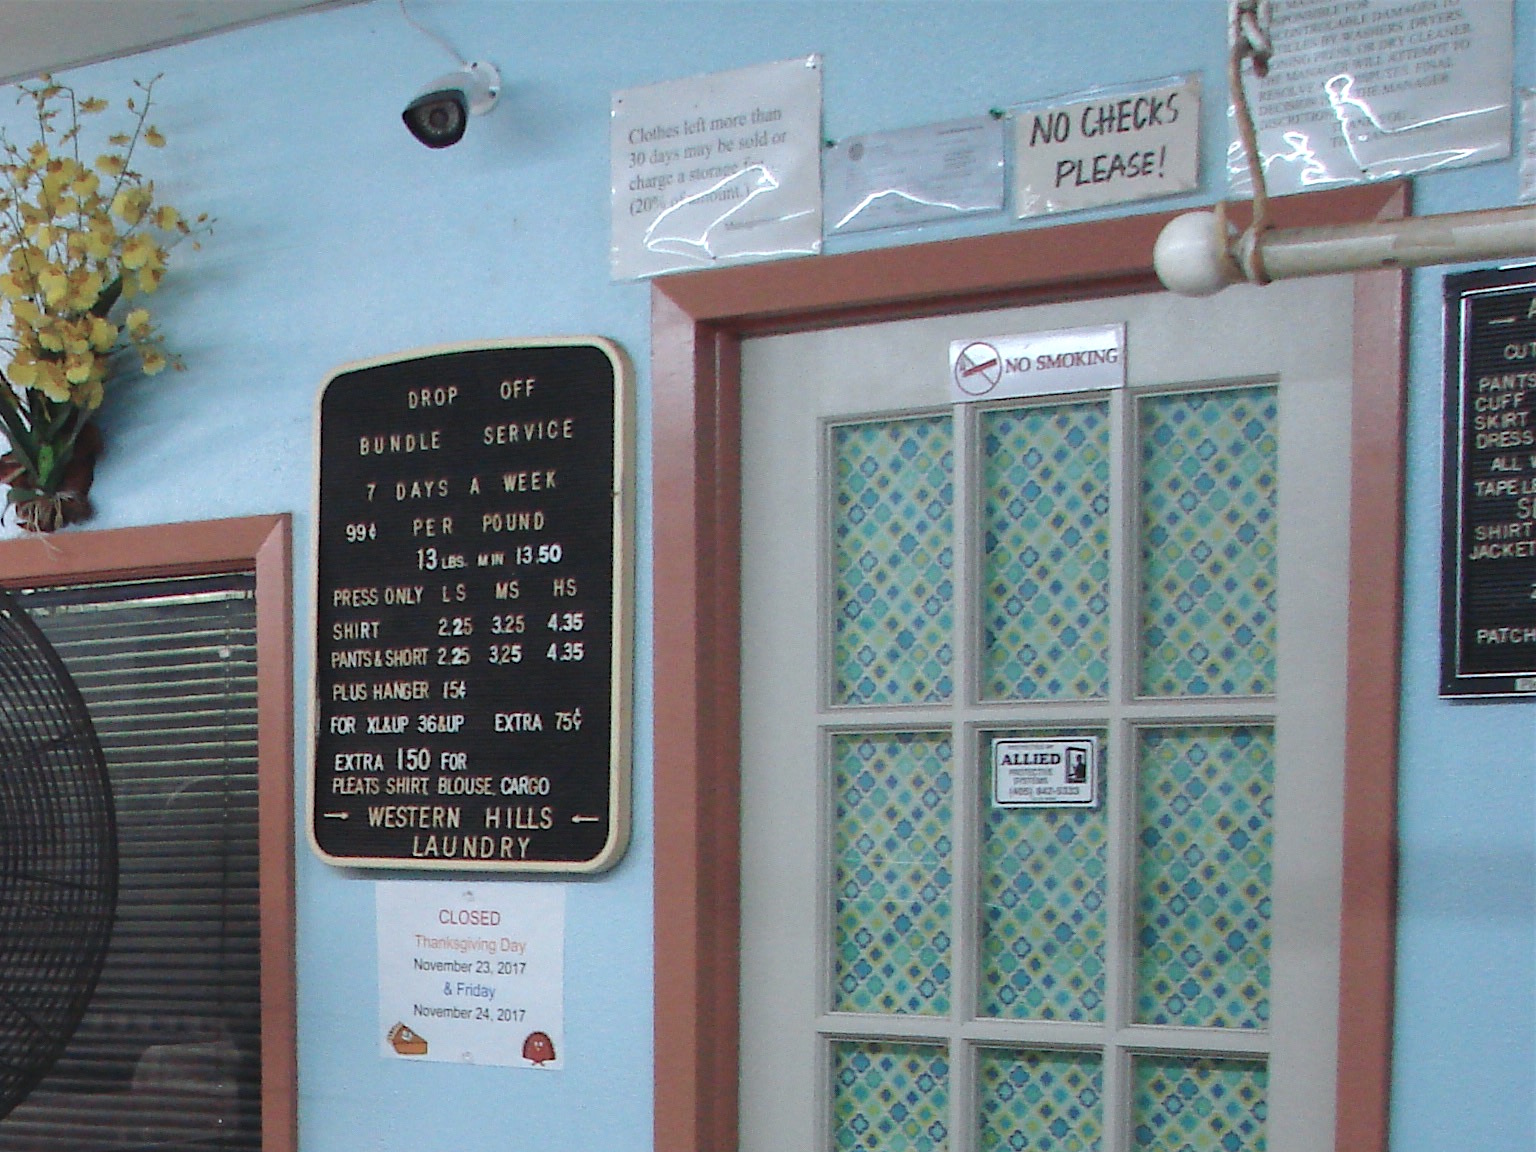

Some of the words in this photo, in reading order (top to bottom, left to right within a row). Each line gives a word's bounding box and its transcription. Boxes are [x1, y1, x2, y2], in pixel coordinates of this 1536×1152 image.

[1411, 9, 1462, 28] DRYERS
[1388, 42, 1448, 62] ATTEMPT
[1454, 38, 1470, 50] TO
[629, 127, 679, 144] Clothes
[684, 117, 705, 135] left
[710, 115, 747, 131] more
[751, 106, 782, 124] than
[1030, 112, 1071, 147] NO
[1081, 94, 1180, 138] CHECKS
[629, 152, 645, 168] 30
[649, 147, 680, 167] days
[684, 144, 712, 160] may
[718, 138, 734, 153] be
[739, 131, 768, 148] sold
[772, 132, 787, 144] or
[1055, 145, 1167, 188] PLEASE!
[629, 173, 673, 191] charge
[677, 172, 685, 183] a
[1005, 357, 1031, 373] NO
[1036, 348, 1118, 371] SMOKING
[408, 386, 459, 410] DROP
[499, 378, 536, 401] OFF
[1478, 374, 1536, 392] PANTS
[1475, 392, 1525, 412] CUFF
[1474, 411, 1529, 431] SKIRT
[359, 431, 442, 455] BUNDLE
[484, 419, 574, 446] SERVICE
[1475, 430, 1534, 449] DRESS
[1490, 457, 1522, 471] ALL
[367, 484, 377, 501] 7
[396, 480, 449, 501] DAYS
[469, 477, 481, 495] A
[503, 470, 557, 493] WEEK
[1474, 479, 1517, 497] TAPE
[346, 523, 377, 543] 99¢
[413, 517, 453, 537] PER
[482, 512, 545, 533] POUND
[1474, 522, 1533, 541] SHIRT
[416, 548, 438, 571] 13
[477, 553, 505, 567] MIN
[515, 544, 563, 566] 13.50
[333, 588, 378, 607] PRESS
[384, 586, 424, 606] ONLY
[495, 580, 520, 600] MS
[553, 578, 578, 597] HS
[332, 620, 381, 641] SHIRT
[438, 617, 473, 637] 2.25
[491, 615, 526, 635] 3.25
[547, 612, 585, 632] 4.35
[436, 646, 471, 666] 2.25
[546, 643, 585, 662] 4.35
[332, 684, 367, 701] PLUS
[373, 680, 429, 700] HANGER
[443, 681, 467, 699] 15¢
[330, 717, 356, 734] FOR
[366, 716, 410, 734] XL&UP
[417, 714, 465, 733] 36&UP
[494, 713, 543, 733] EXTRA
[554, 708, 583, 731] 75¢
[334, 753, 384, 772] EXTRA
[396, 747, 431, 771] 150
[440, 753, 468, 771] FOR
[1001, 753, 1061, 766] ALLIED
[332, 777, 380, 795] PLEATS
[386, 777, 429, 796] SHIRT
[499, 776, 550, 796] CARGO
[368, 806, 461, 829] WESTERN
[485, 806, 554, 830] HILLS
[412, 835, 531, 859] LAUNDRY
[439, 909, 501, 926] CLOSED
[415, 934, 497, 955] Thanksgiving
[501, 938, 527, 955] Day
[414, 958, 472, 972] November
[498, 962, 526, 975] 2017
[443, 981, 452, 996] &
[457, 982, 496, 1000] Friday
[414, 1005, 473, 1020] November
[497, 1009, 526, 1022] 2017
